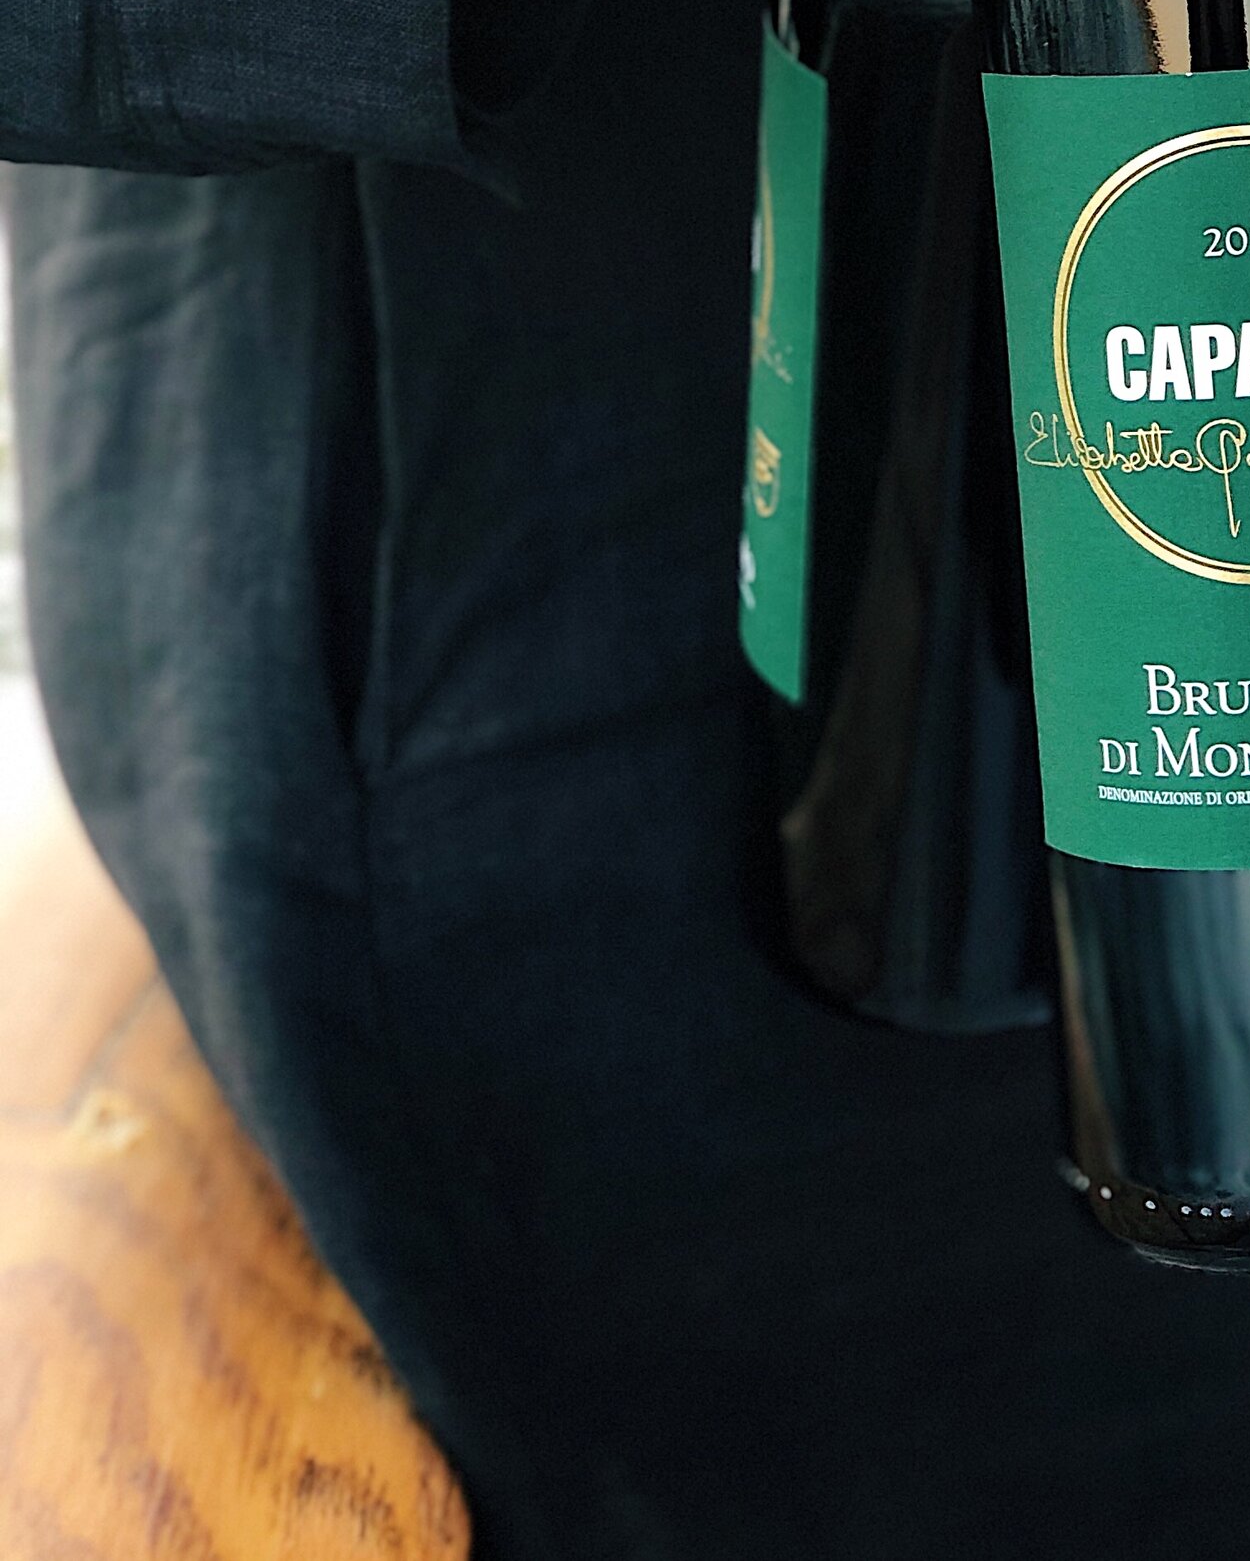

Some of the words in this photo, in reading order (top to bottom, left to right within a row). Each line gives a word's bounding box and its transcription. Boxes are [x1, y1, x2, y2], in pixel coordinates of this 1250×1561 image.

[1098, 738, 1142, 776] DI
[1097, 784, 1204, 807] DENOMINAZIONE
[1205, 790, 1223, 806] DI
